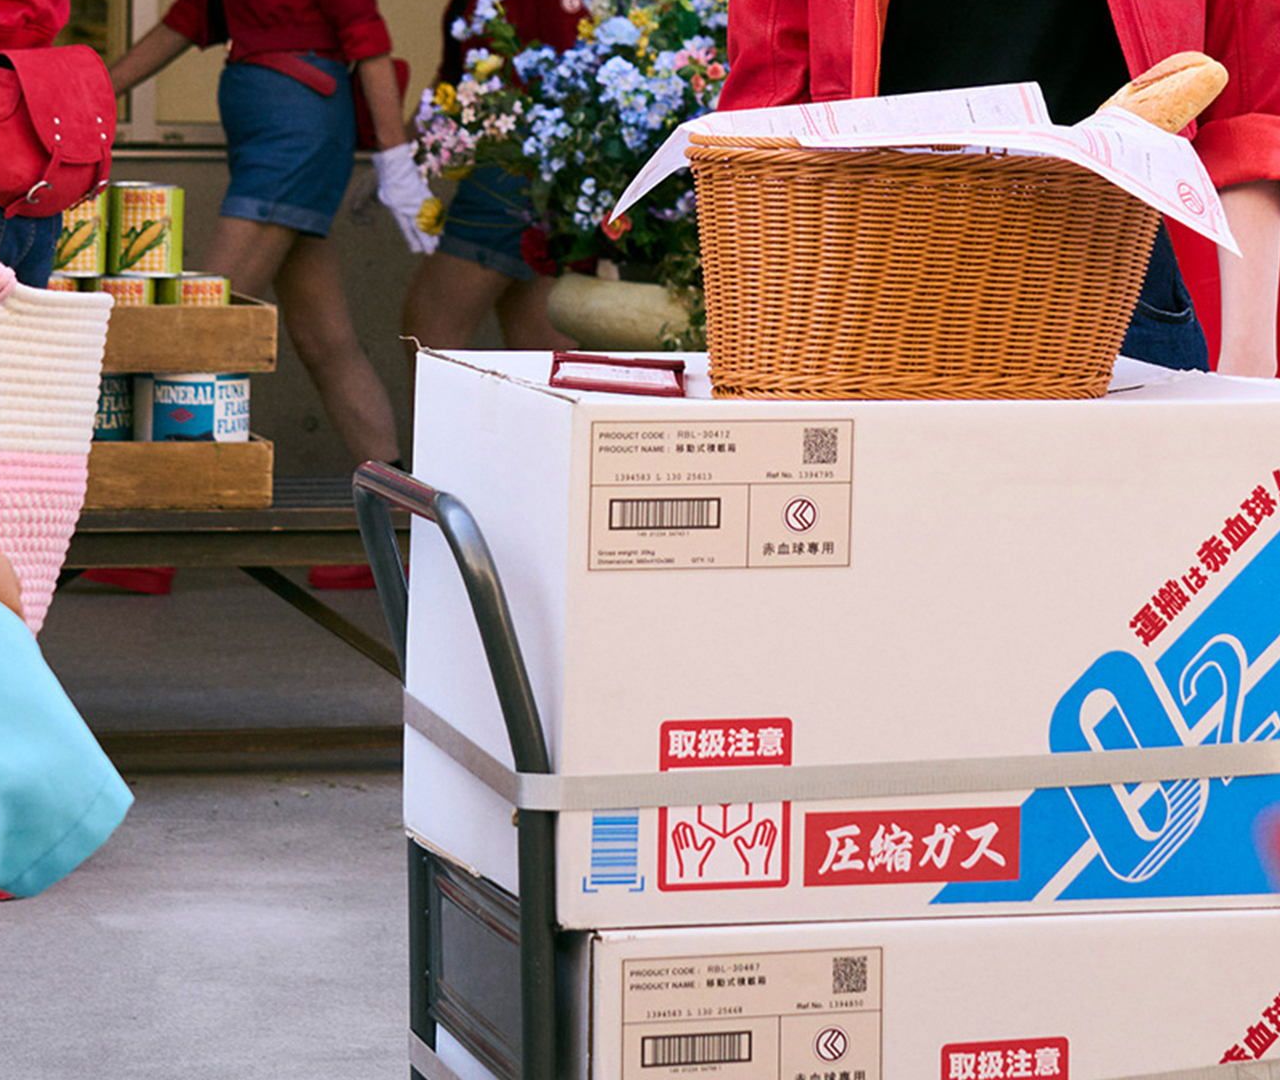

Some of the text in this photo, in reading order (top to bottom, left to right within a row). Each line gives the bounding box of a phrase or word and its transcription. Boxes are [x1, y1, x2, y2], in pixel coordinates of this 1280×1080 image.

[154, 384, 214, 405] MINERAL
[218, 384, 245, 401] TUNA
[599, 431, 639, 440] PRODUCT
[599, 445, 639, 453] PRODUCT
[667, 727, 785, 759] 取扱注意
[818, 822, 1007, 876] 圧縮ガス
[948, 1046, 1062, 1080] 取扱注意
